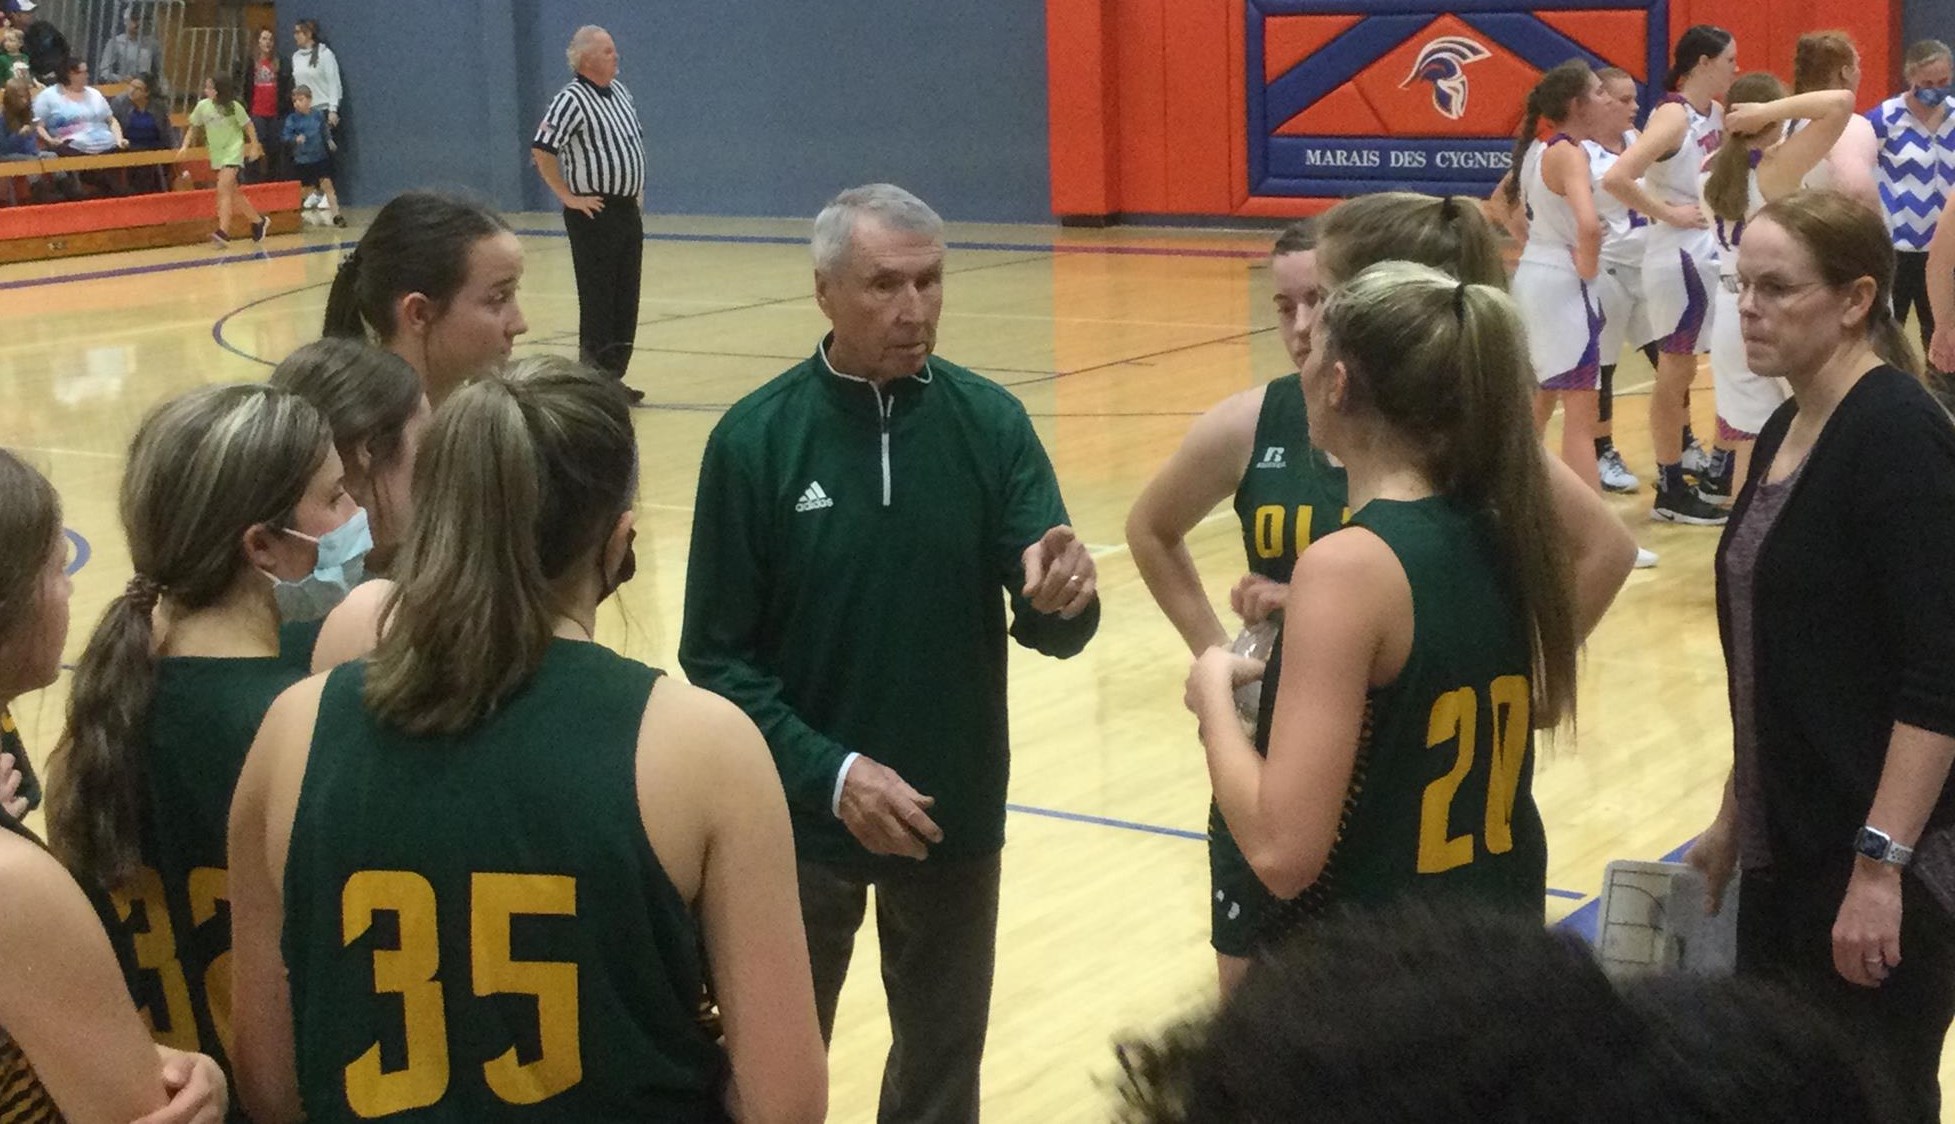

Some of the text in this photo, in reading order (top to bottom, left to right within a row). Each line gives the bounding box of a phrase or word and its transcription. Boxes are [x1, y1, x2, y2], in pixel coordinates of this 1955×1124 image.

[1306, 150, 1514, 169] MARAIS DES CYGNES
[795, 497, 834, 512] adidas
[1417, 674, 1530, 874] 20
[342, 869, 583, 1118] 35
